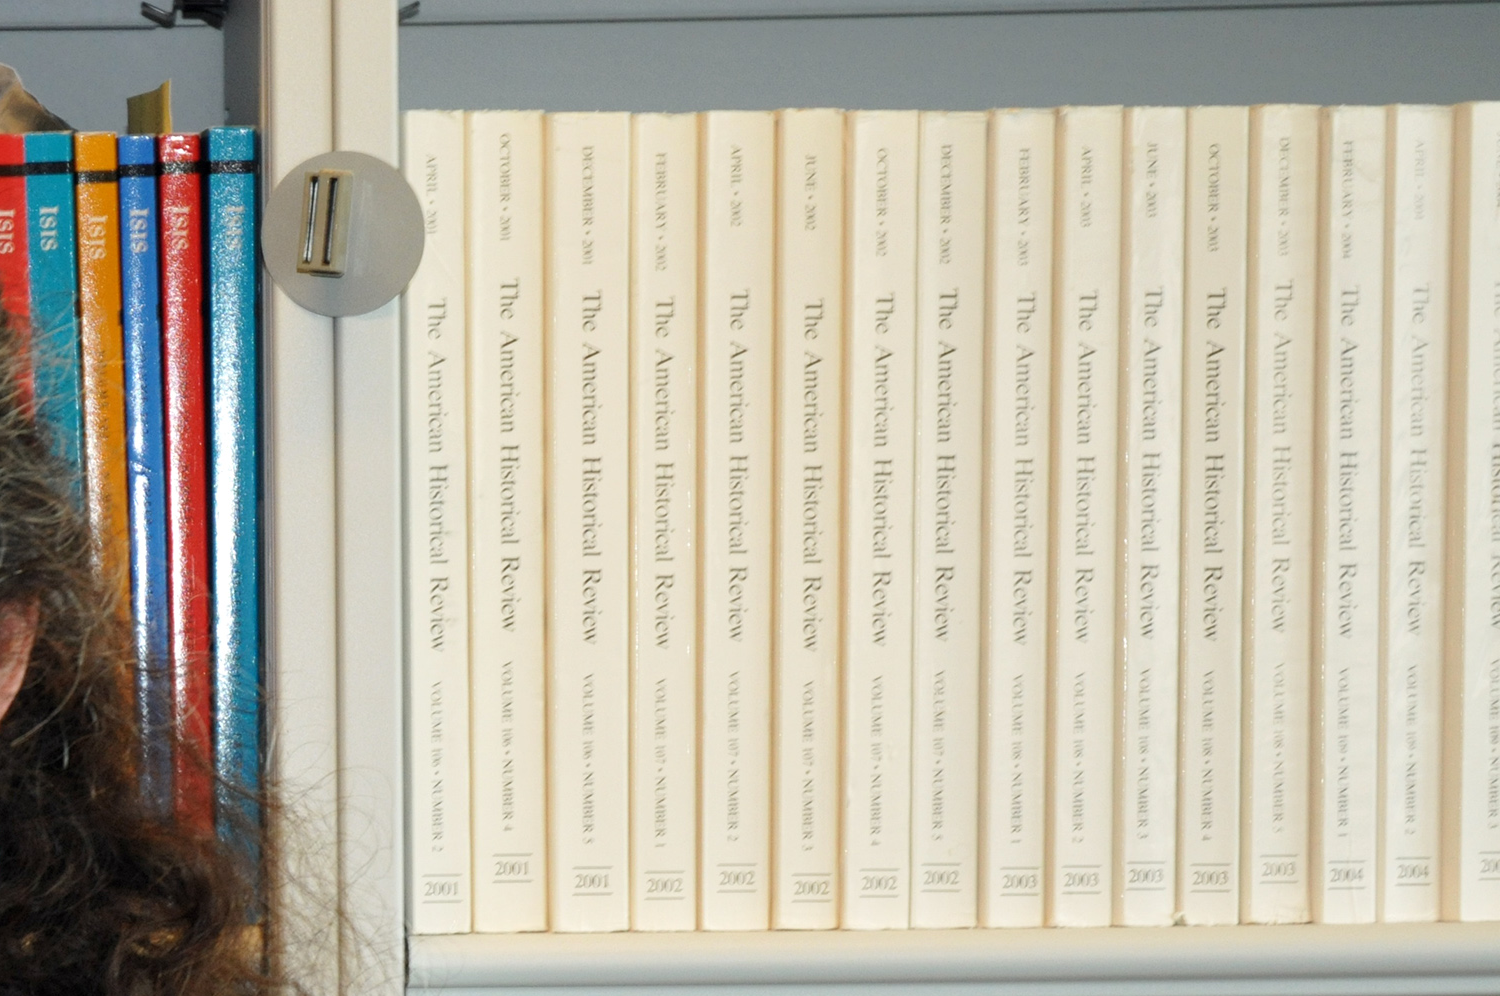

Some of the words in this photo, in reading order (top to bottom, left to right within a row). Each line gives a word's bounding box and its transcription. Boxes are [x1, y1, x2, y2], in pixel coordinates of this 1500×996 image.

[581, 146, 594, 228] DECEMBER
[804, 153, 817, 193] JUNE
[1207, 143, 1221, 213] OCTOBER
[39, 205, 59, 252] ISIS
[88, 215, 108, 260] ISIS
[129, 208, 149, 254] ISIS
[170, 205, 190, 251] ISIS
[581, 290, 603, 332] The
[803, 298, 825, 340] The
[1205, 287, 1228, 329] The
[581, 343, 603, 445] American
[803, 351, 824, 453] American
[1204, 341, 1227, 442] American
[581, 457, 603, 557] Historical
[802, 465, 824, 564] Historical
[1203, 454, 1226, 554] Historical
[581, 569, 603, 644] Review
[802, 576, 824, 651] Review
[1202, 566, 1225, 641] Review
[582, 673, 595, 737] VOLUME
[802, 680, 814, 742] VOLUME
[1201, 670, 1215, 732] VOLUME
[582, 772, 595, 834] NUMBER
[802, 778, 814, 840] NUMBER
[1201, 768, 1215, 830] NUMBER
[574, 873, 610, 889] 2001
[794, 880, 831, 895] 2002
[1192, 870, 1230, 885] 2003
